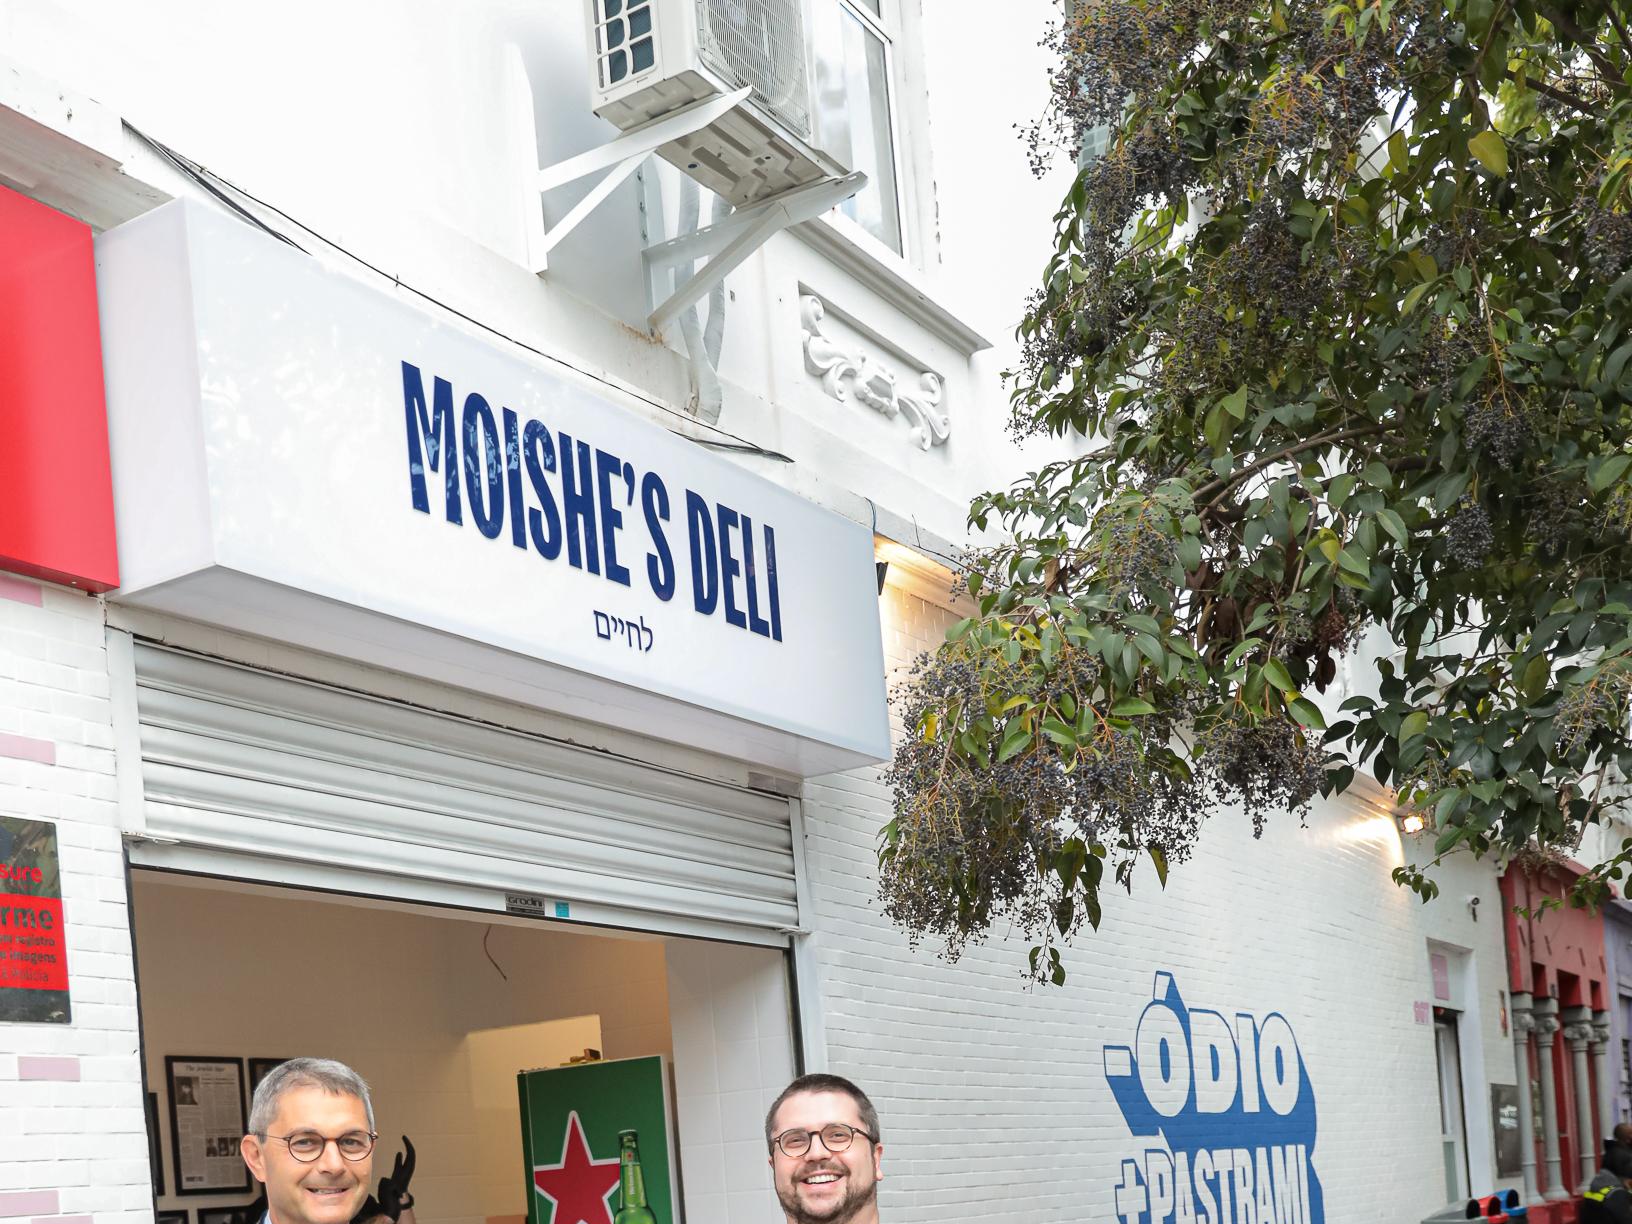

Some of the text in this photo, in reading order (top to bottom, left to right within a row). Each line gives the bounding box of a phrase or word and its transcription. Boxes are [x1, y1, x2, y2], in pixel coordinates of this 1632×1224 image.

[402, 360, 783, 643] MOISHE'S DELI
[593, 610, 653, 653] לחיים
[16, 933, 56, 948] registro
[9, 947, 57, 965] imagens
